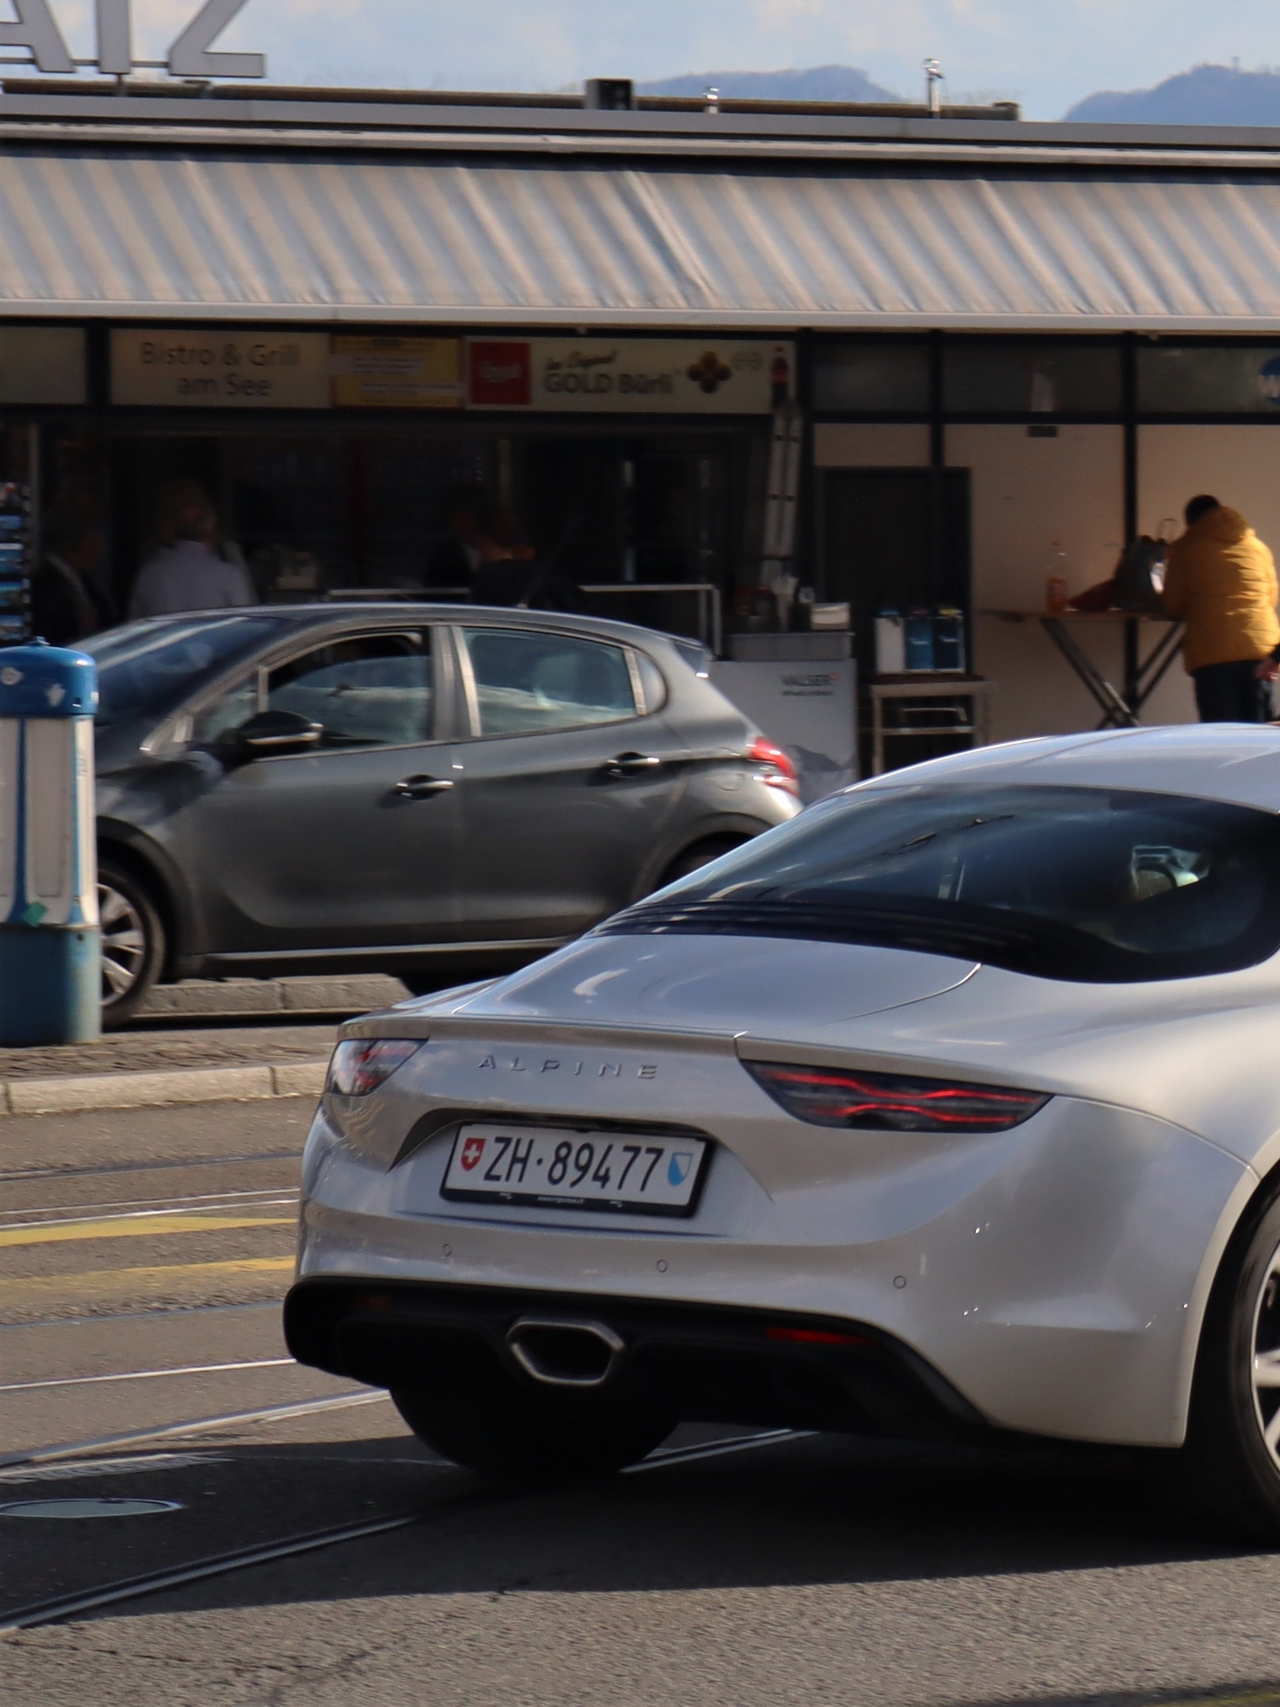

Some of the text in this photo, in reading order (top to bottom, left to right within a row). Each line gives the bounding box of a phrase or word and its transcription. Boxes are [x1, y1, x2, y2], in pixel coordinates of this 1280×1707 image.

[140, 341, 215, 366] Bistro
[222, 343, 242, 366] &
[177, 373, 272, 397] am See
[543, 372, 614, 394] GOLD
[477, 1054, 659, 1080] ALPINE
